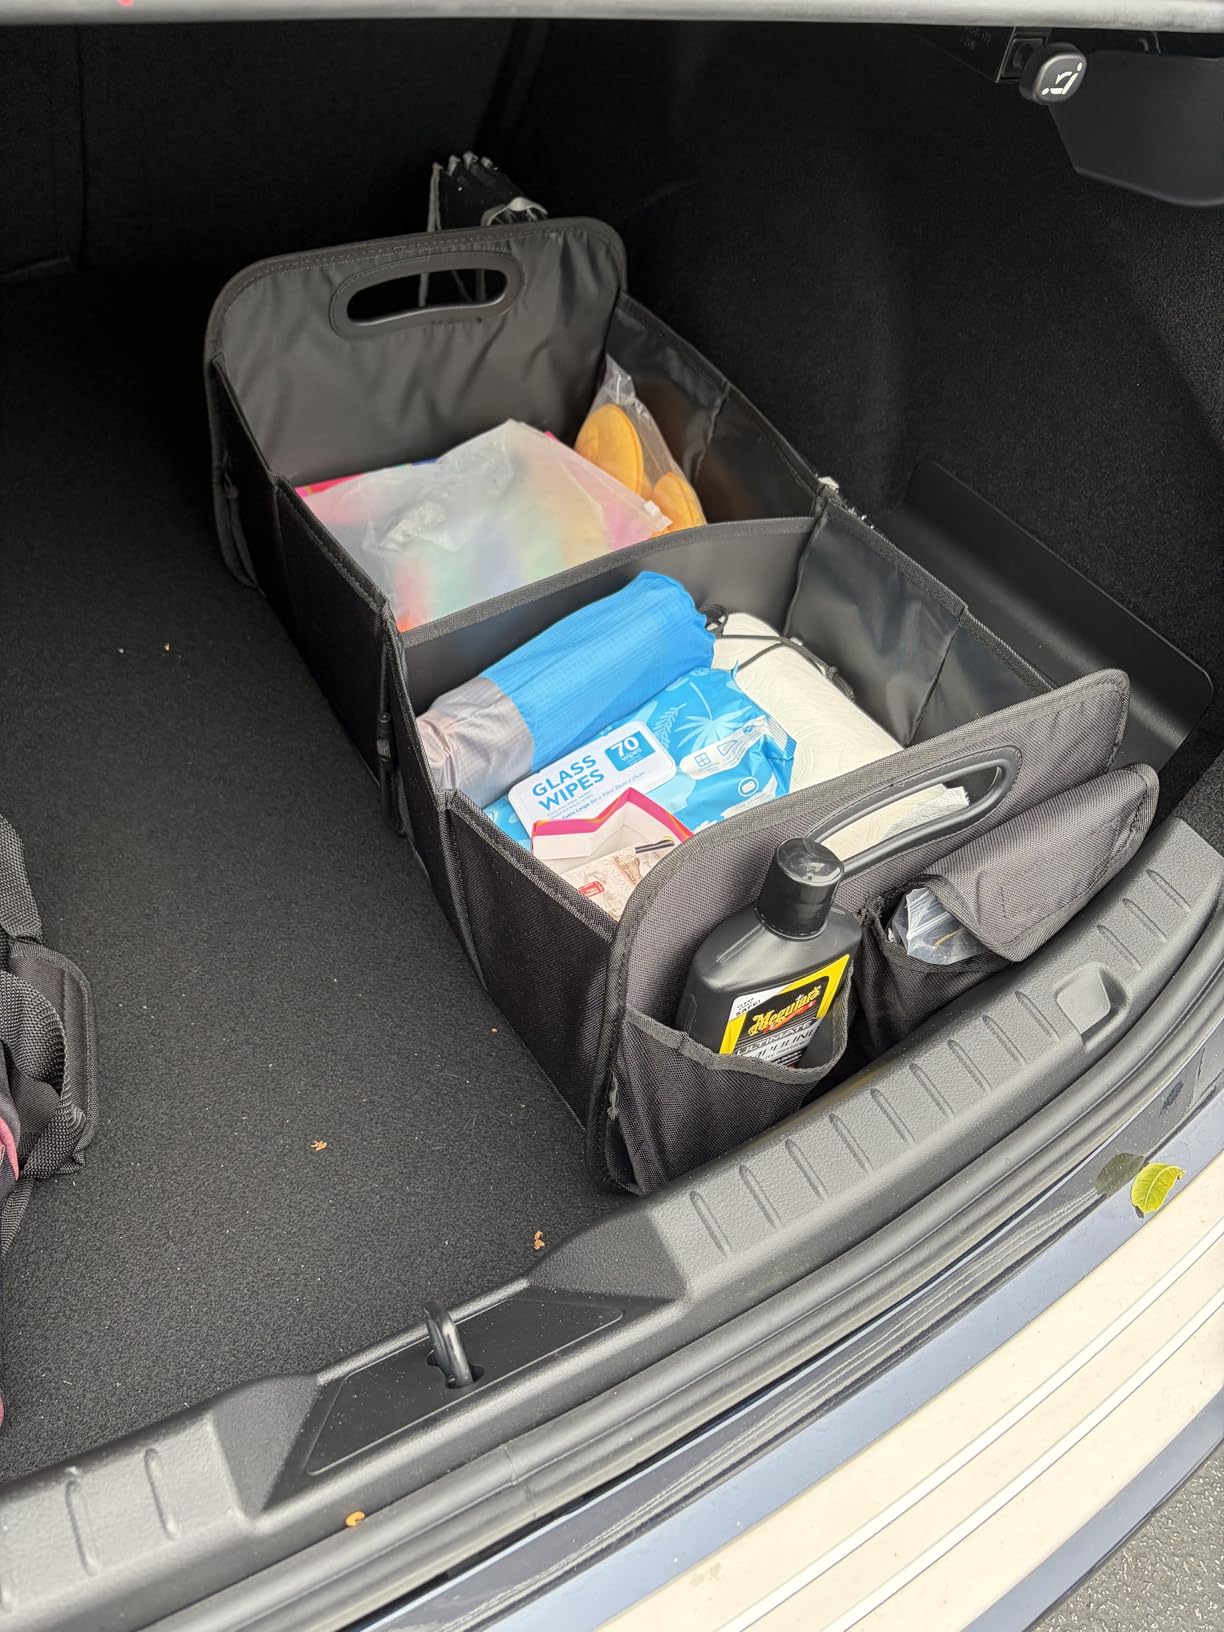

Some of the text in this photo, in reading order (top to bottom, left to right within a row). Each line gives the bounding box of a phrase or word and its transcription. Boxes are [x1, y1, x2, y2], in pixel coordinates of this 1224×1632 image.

[610, 736, 640, 758] 70
[532, 754, 597, 796] GLASS
[538, 769, 605, 811] WIPES
[748, 985, 822, 1037] Meguiar's
[736, 1021, 813, 1056] ULTIMATE
